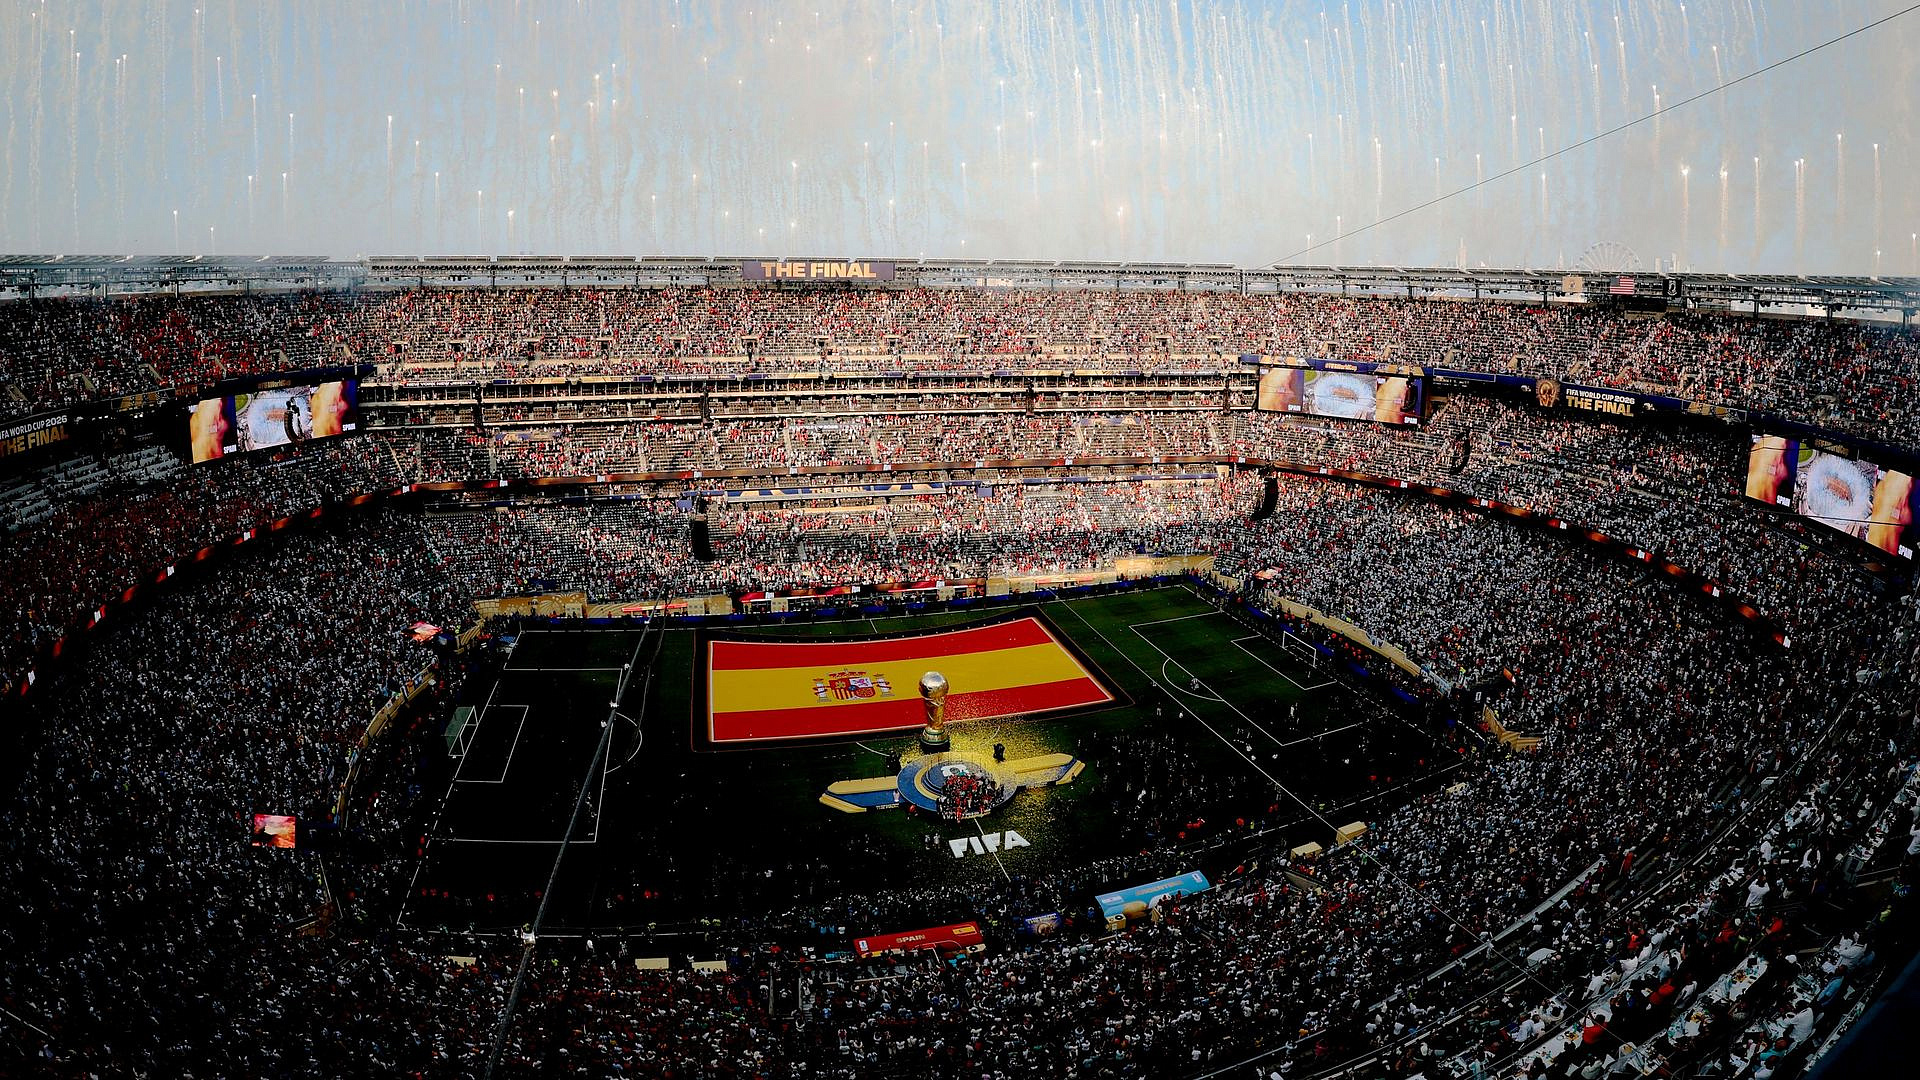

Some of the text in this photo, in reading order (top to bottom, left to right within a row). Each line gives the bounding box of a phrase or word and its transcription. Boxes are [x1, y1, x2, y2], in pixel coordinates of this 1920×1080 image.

[761, 262, 877, 278] THE FINAL
[1566, 388, 1636, 405] FIFA WORLD CUP 2026
[1566, 395, 1634, 417] THE FINAL
[9, 423, 33, 437] WORLD
[32, 420, 46, 431] CUP
[45, 415, 68, 427] 2026
[27, 424, 69, 450] FINAL
[949, 830, 1031, 858] FIFA
[896, 934, 926, 943] SPAIN
